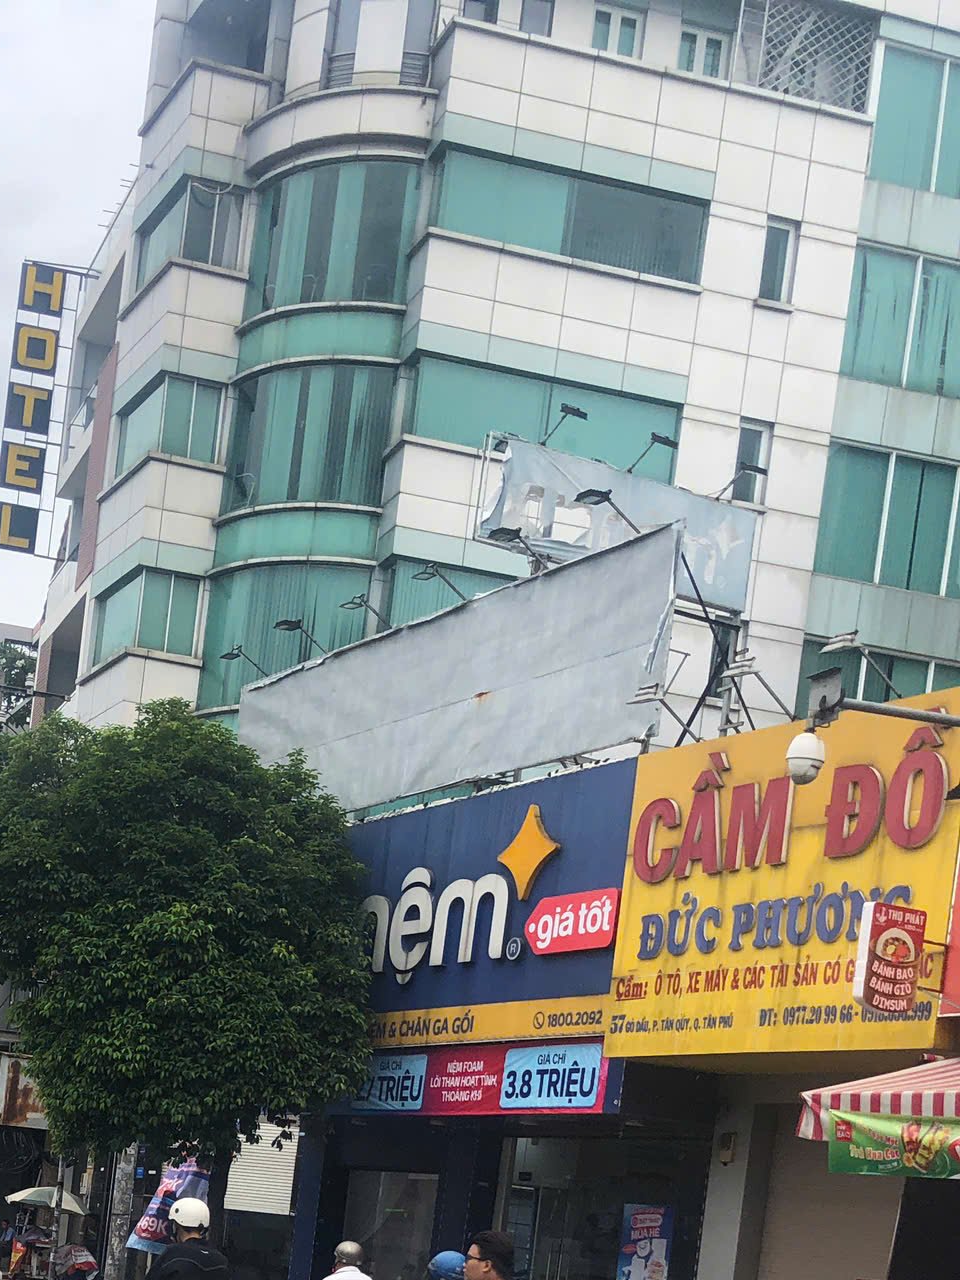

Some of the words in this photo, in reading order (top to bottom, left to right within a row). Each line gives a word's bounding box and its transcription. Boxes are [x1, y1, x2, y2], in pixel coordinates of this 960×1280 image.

[0, 264, 64, 549] HOTEL
[633, 752, 794, 883] CẦM
[824, 708, 947, 858] ĐỒ
[536, 902, 574, 949] giá
[577, 895, 613, 935] tốt
[637, 892, 722, 960] ĐỨC
[888, 909, 904, 924] THỌ
[904, 910, 926, 926] PHÁT
[654, 969, 663, 995] Ô
[667, 968, 683, 998] TÔ,
[686, 971, 702, 994] XE
[704, 964, 729, 992] MÁY
[731, 969, 740, 991] &
[743, 960, 766, 990] CÁC
[770, 960, 790, 988] TÀI
[793, 955, 819, 987] SẢN
[823, 953, 841, 985] CÓ
[871, 960, 895, 979] BÁNH
[896, 965, 914, 979] BAO
[869, 977, 893, 994] BÁNH
[893, 981, 912, 996] GIÒ
[872, 994, 908, 1011] DIMSUM
[388, 1021, 397, 1038] &
[399, 1016, 431, 1037] CHĂN
[433, 1017, 449, 1036] GA
[452, 1009, 475, 1034] GỐI
[547, 1009, 603, 1028] 1800.2092
[610, 1014, 626, 1034] 57
[718, 1012, 734, 1029] PHÚ
[759, 1008, 778, 1026] ĐT:
[824, 1004, 837, 1024] 99
[840, 1004, 853, 1023] 66
[463, 1061, 484, 1073] FOAM
[537, 1051, 551, 1065] GIÁ
[377, 1069, 424, 1108] TRIỆU
[504, 1069, 533, 1099] 3.8
[536, 1060, 597, 1104] TRIỆU
